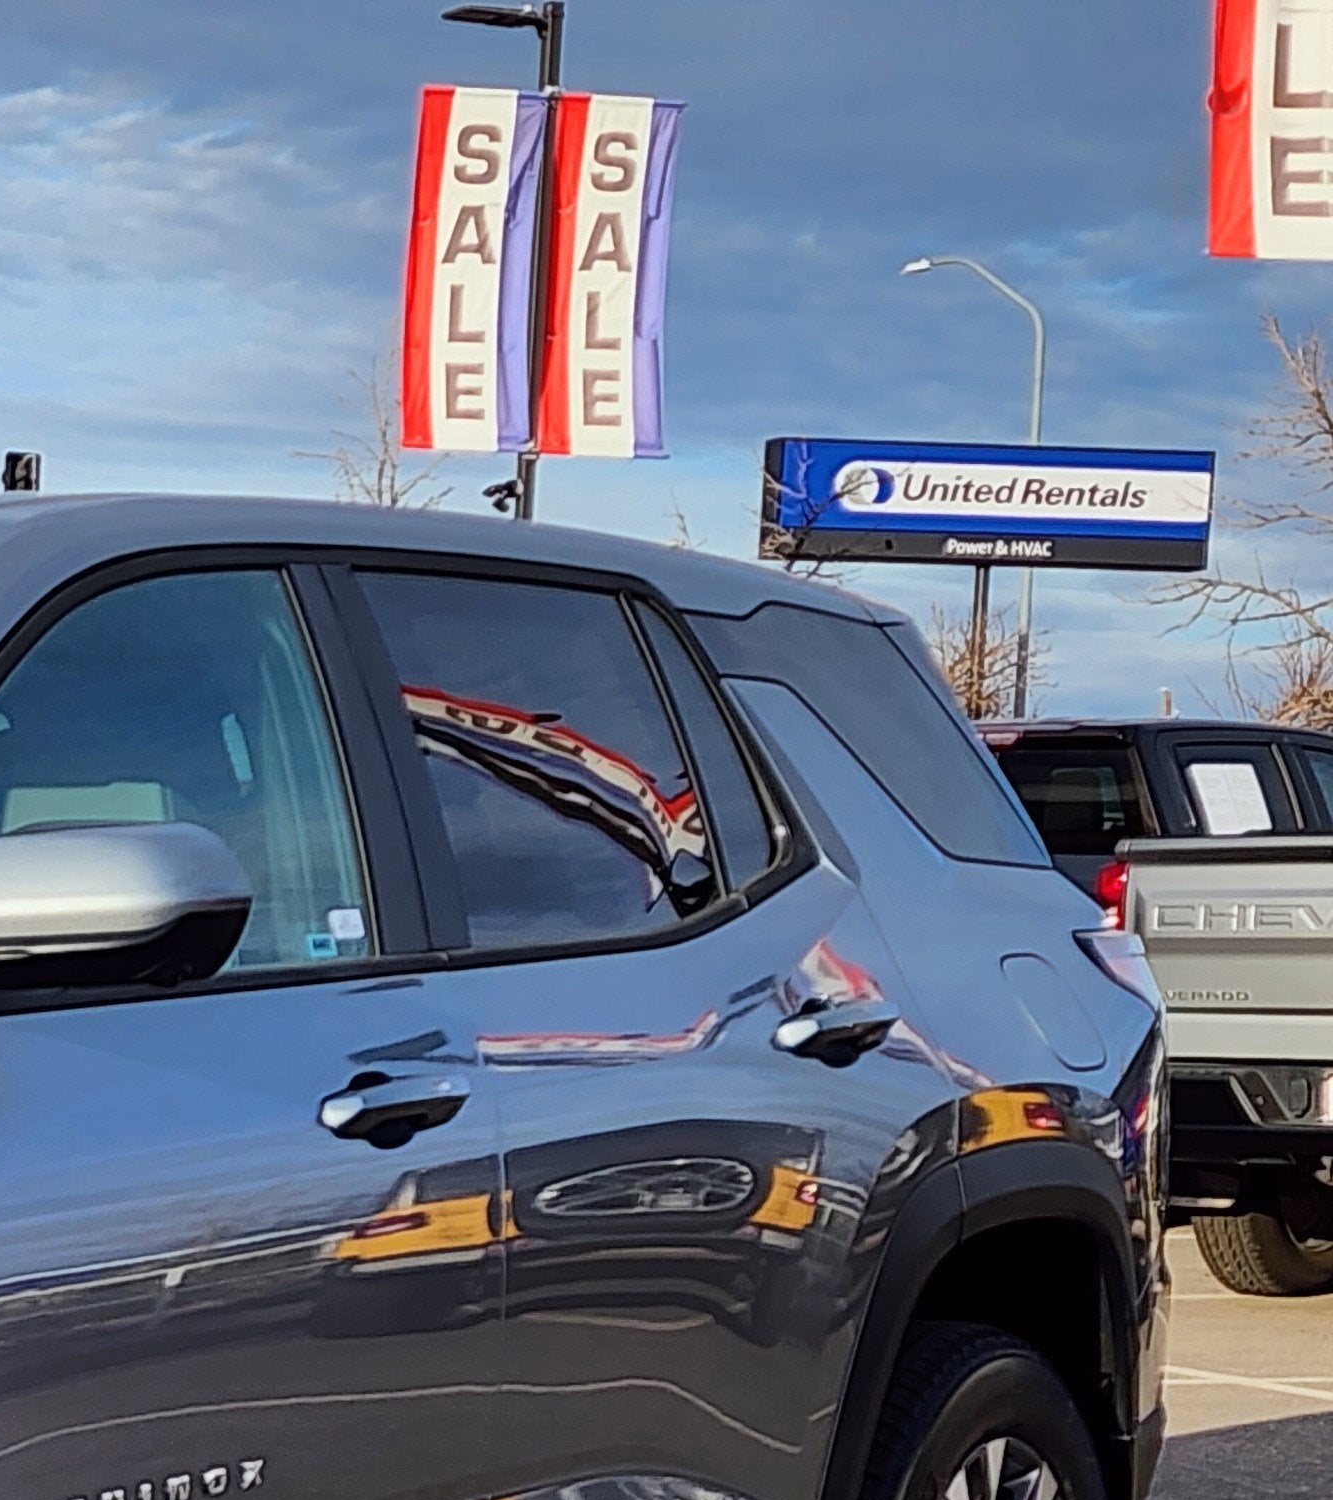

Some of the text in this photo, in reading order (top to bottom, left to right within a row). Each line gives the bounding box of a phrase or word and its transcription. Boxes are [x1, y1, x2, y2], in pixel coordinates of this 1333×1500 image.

[441, 123, 502, 420] SALE
[578, 131, 639, 426] SALE
[902, 473, 1148, 509] United Rentals
[946, 537, 1053, 557] Power & HVAC
